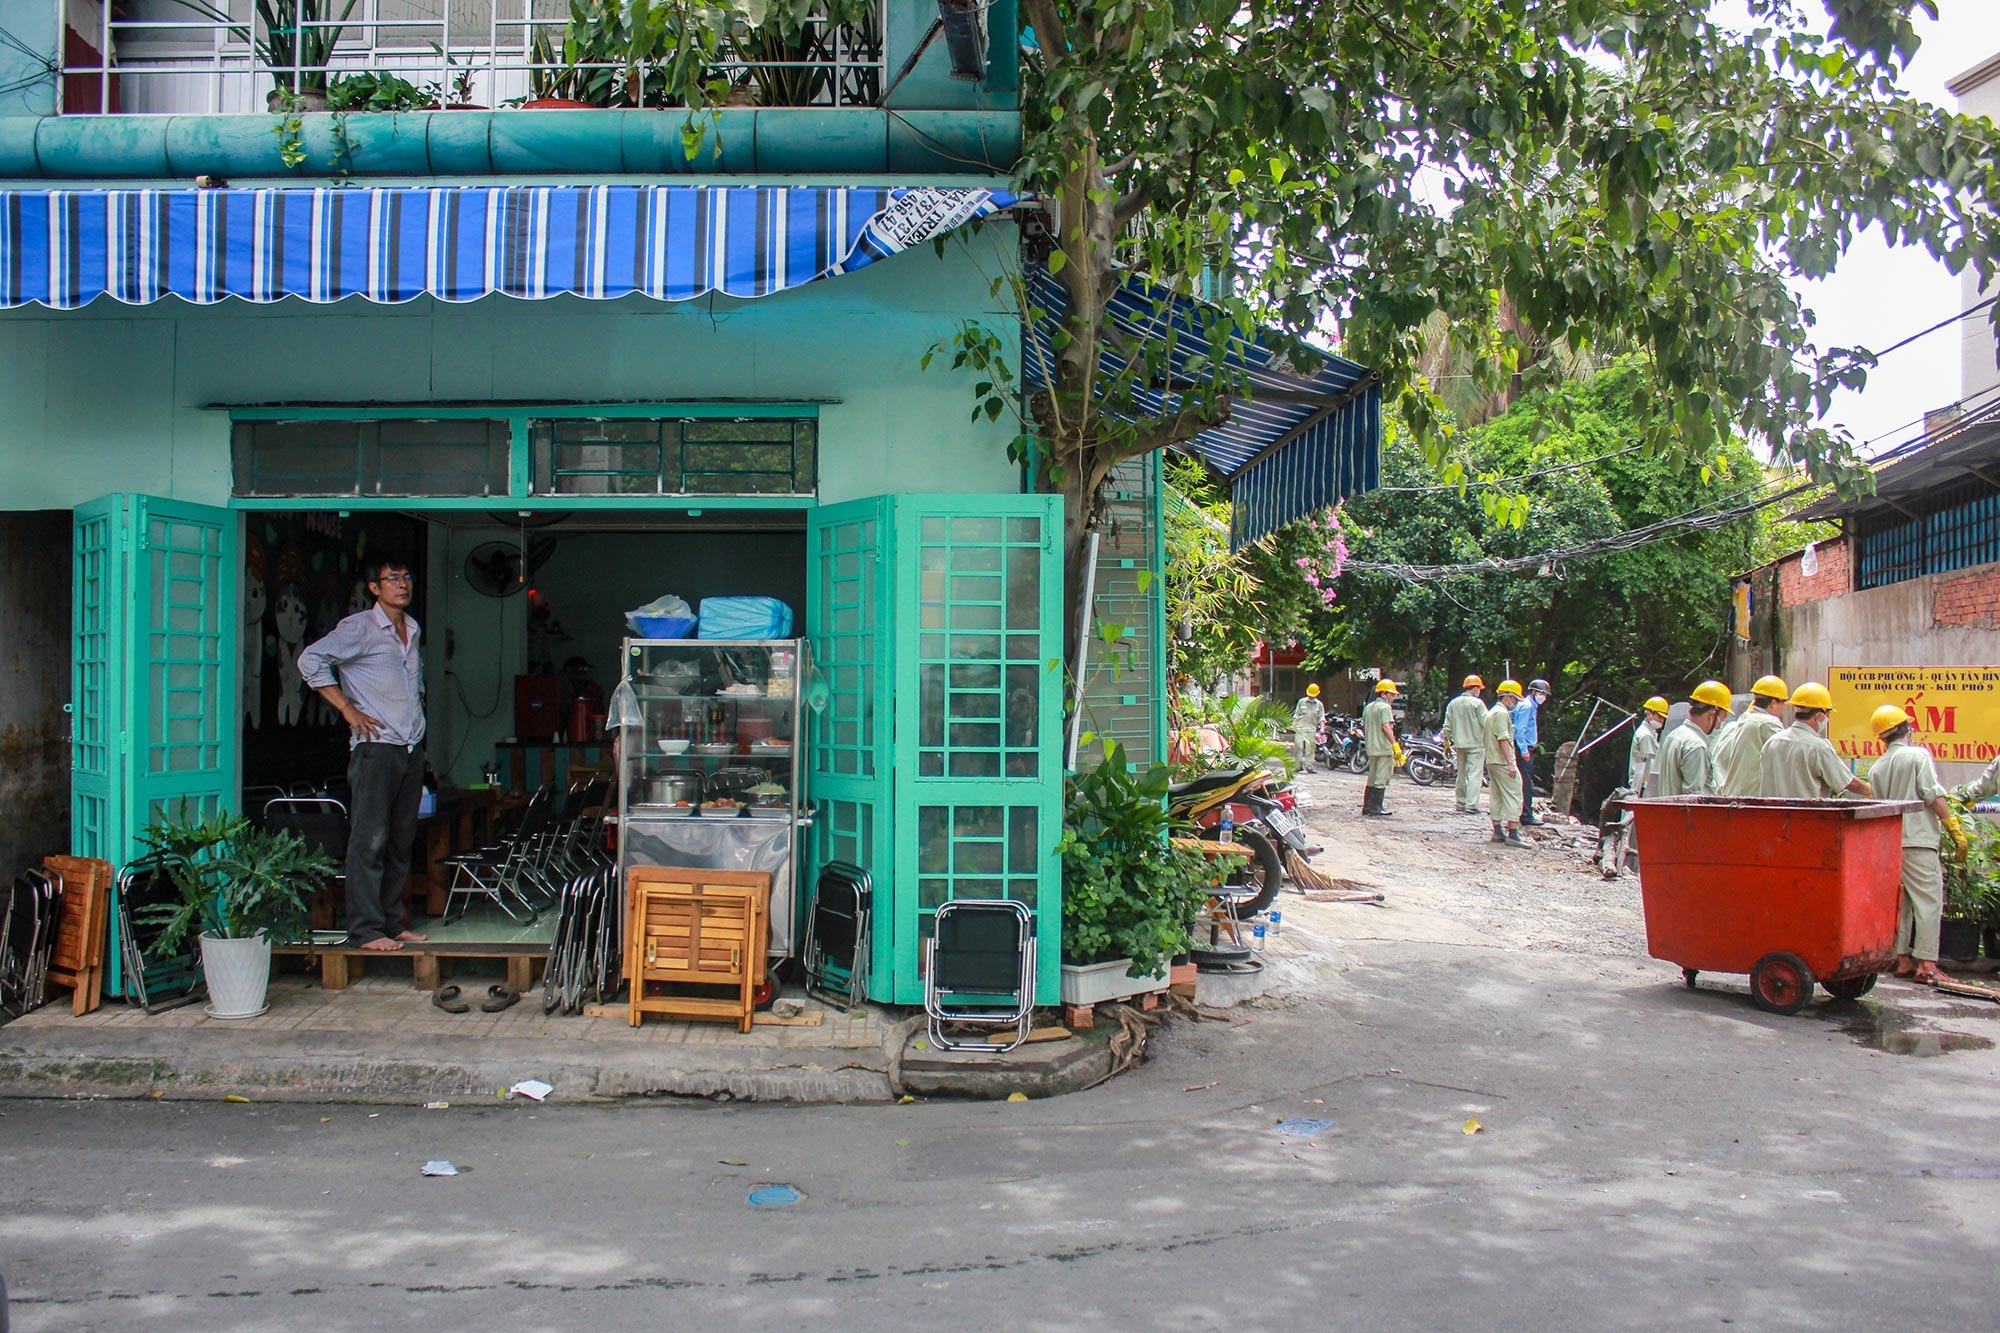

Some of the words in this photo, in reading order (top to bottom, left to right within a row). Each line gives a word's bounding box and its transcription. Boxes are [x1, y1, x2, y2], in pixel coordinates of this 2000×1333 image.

[1840, 671, 1856, 682] HỘI
[1858, 672, 1876, 681] CCB
[1878, 671, 1915, 681] PHƯỜNG
[1931, 670, 1957, 683] QUẬN
[1959, 670, 1979, 681] TÂN
[1982, 671, 2000, 681] BÌN
[1874, 682, 1892, 692] HỘI
[1895, 683, 1914, 691] CCB
[1936, 683, 1957, 691] KHU
[1987, 683, 1994, 691] 9
[1904, 692, 1957, 733] ẤM
[1952, 740, 2000, 761] MƯƠN
